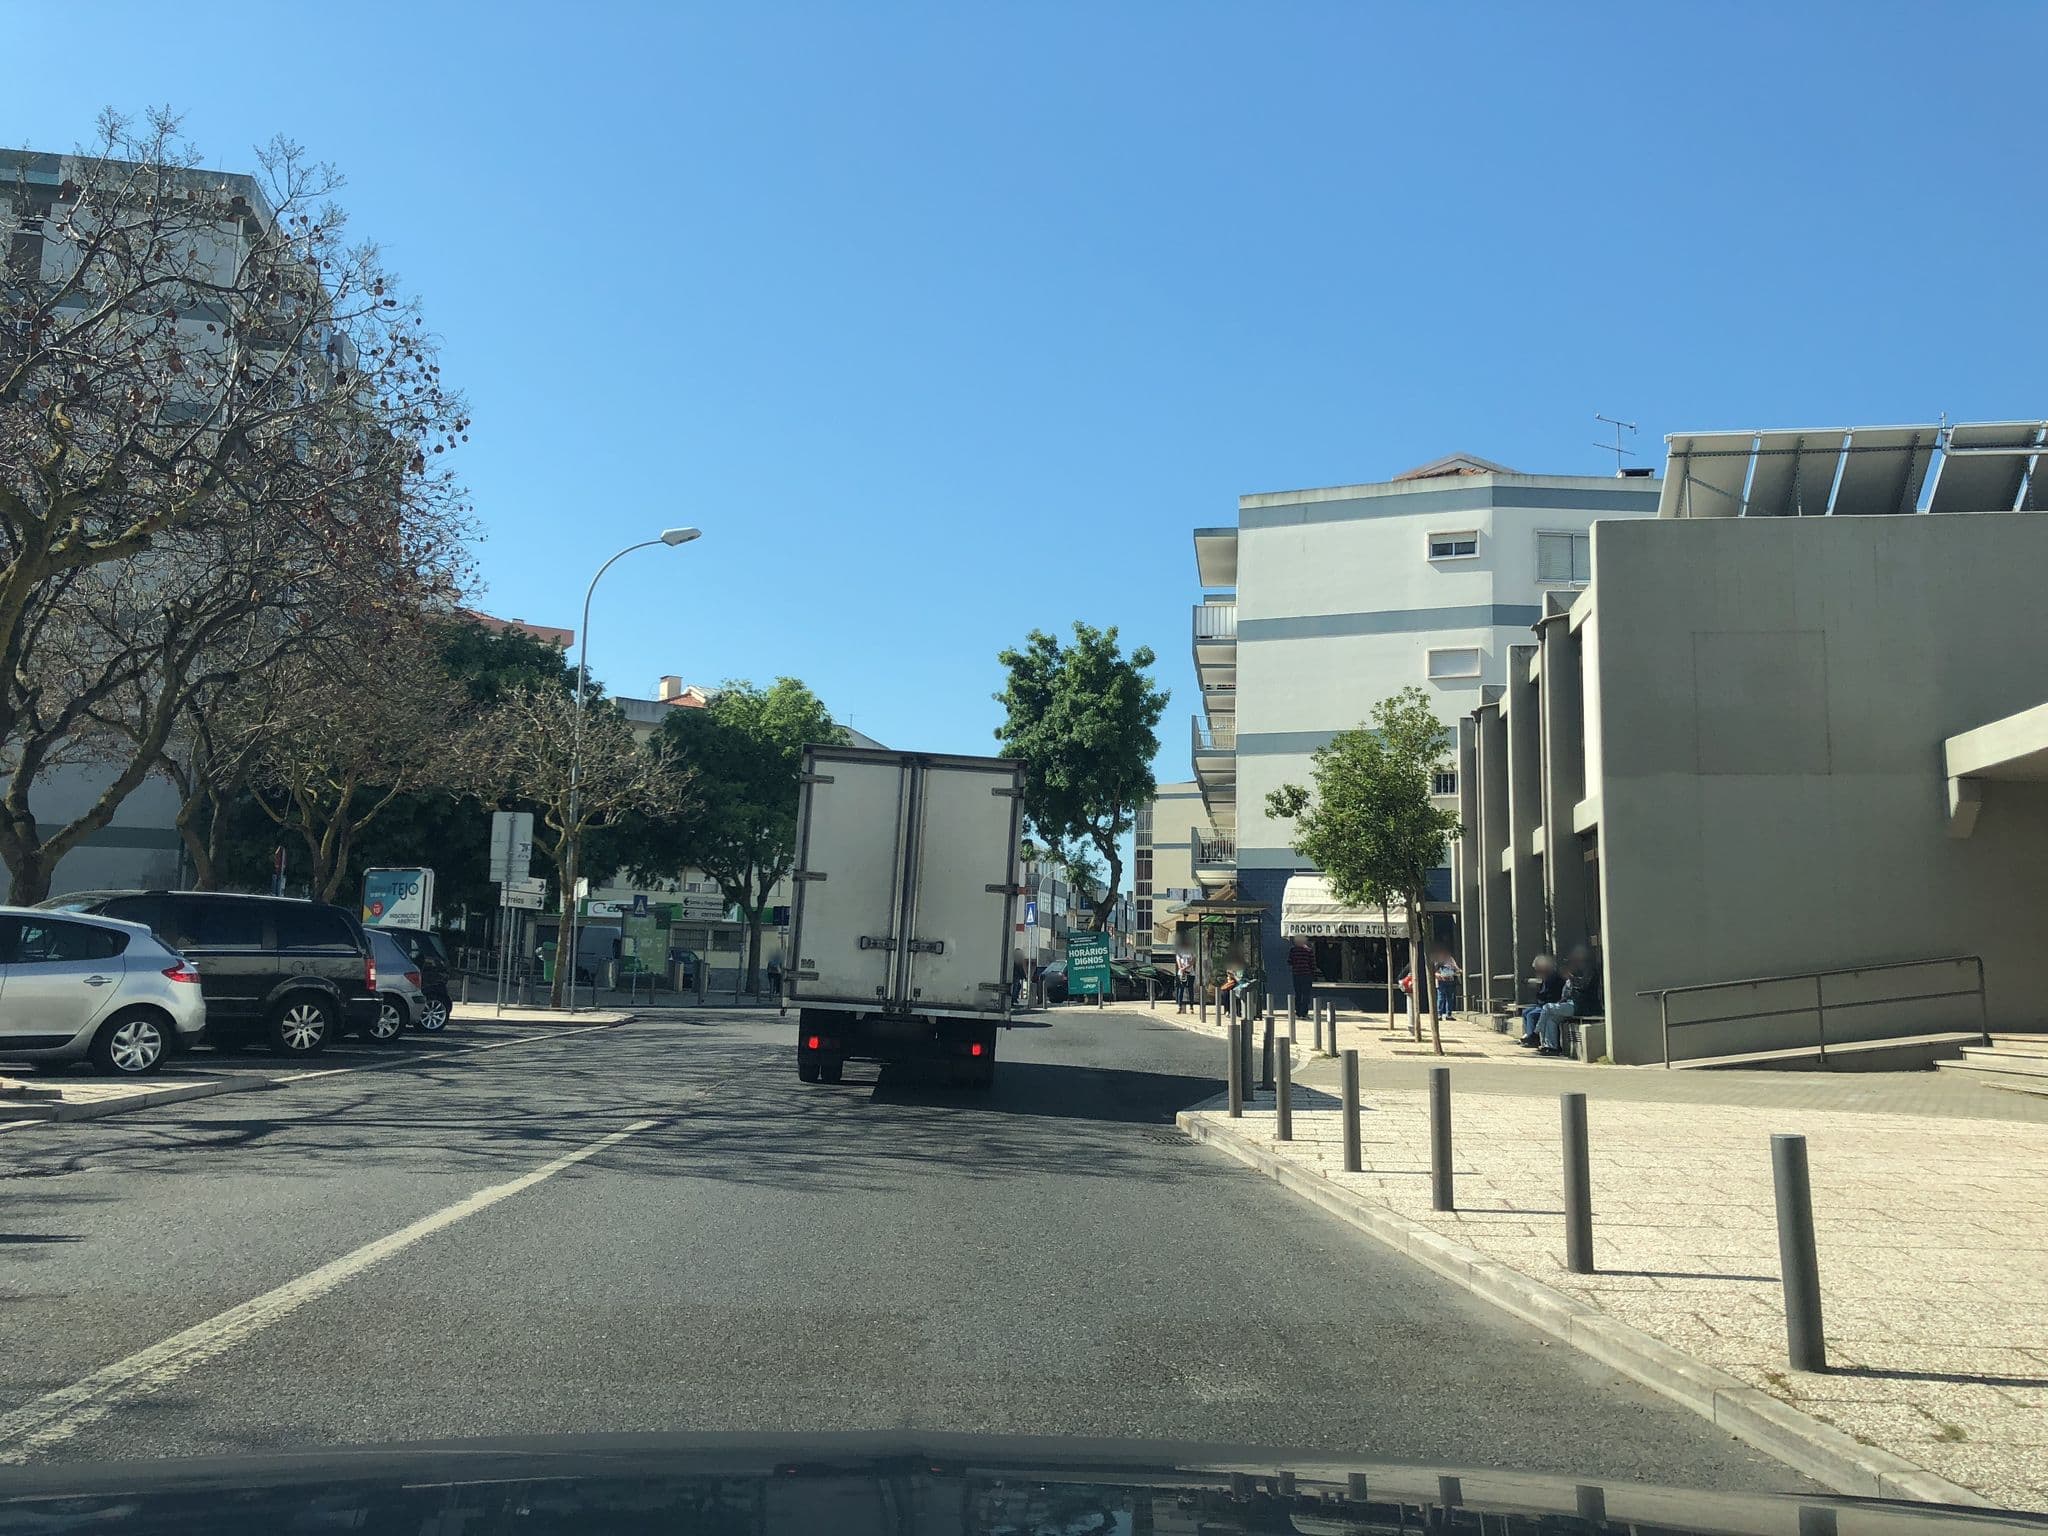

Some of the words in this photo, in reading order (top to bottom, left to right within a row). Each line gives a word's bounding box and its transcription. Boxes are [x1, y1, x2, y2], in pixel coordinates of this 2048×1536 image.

[391, 881, 419, 900] TEJO
[1290, 924, 1323, 934] PRONTO
[1068, 946, 1109, 958] HORÁRIOS
[1074, 955, 1104, 966] DIGNOS
